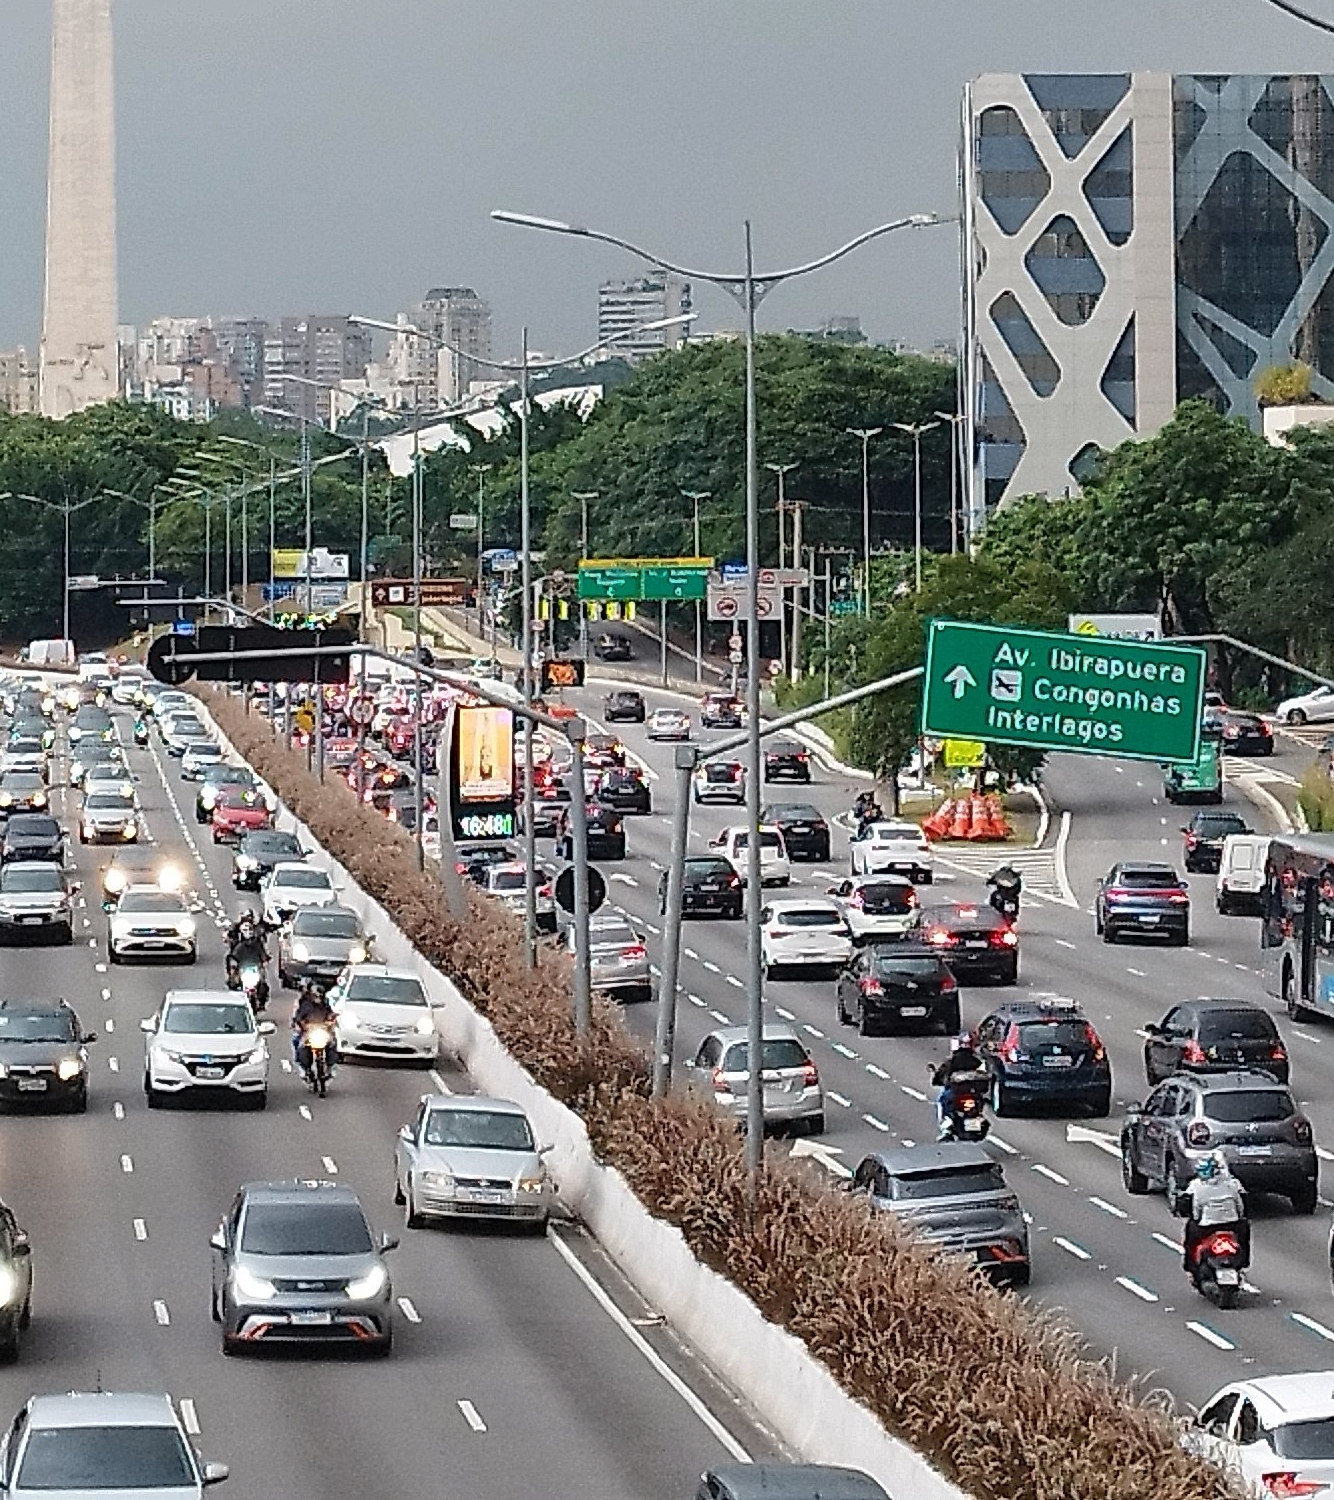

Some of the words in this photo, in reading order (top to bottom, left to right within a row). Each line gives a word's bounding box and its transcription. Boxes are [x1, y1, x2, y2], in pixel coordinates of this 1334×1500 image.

[994, 642, 1036, 667] Av.
[1052, 647, 1186, 683] Ibirapuera
[1035, 678, 1181, 714] Congonhas
[988, 705, 1124, 744] Interlagos
